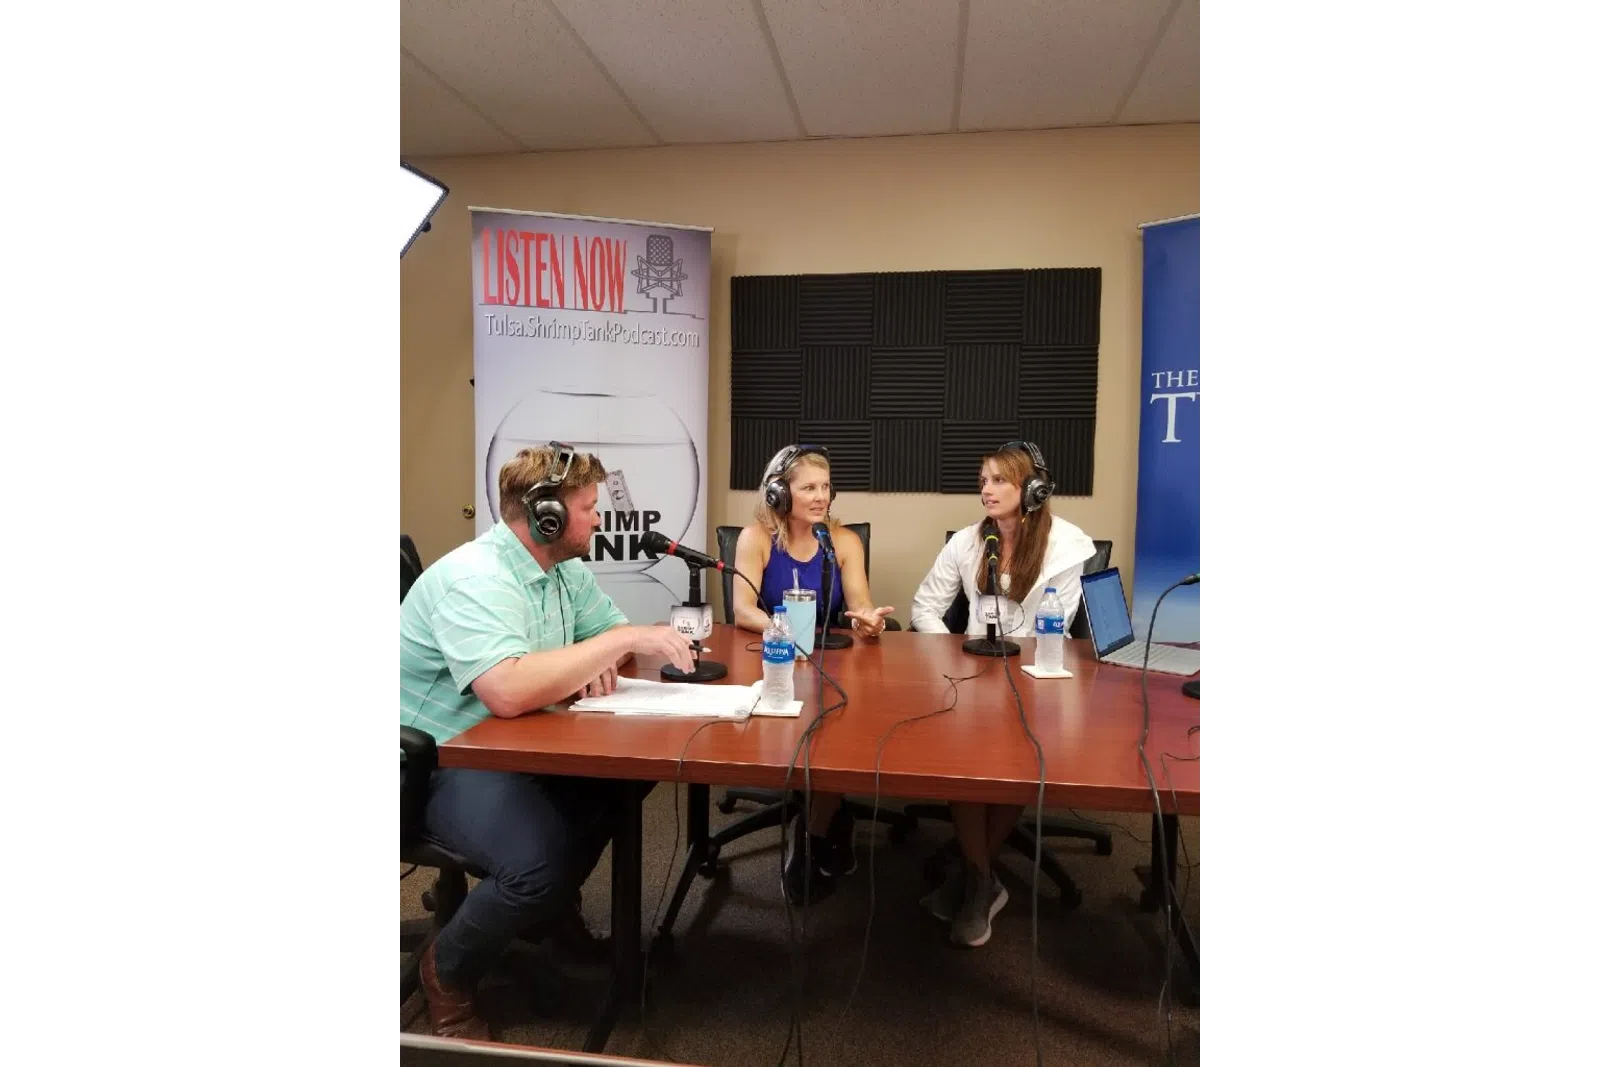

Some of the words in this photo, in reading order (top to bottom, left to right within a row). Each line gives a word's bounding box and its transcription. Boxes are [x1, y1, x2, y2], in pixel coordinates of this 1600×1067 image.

[482, 227, 565, 309] LISTEN
[573, 235, 627, 313] NOW
[485, 313, 700, 347] Tulsa.ShrimpTankPodcast.com
[1151, 370, 1199, 388] THE
[1150, 392, 1200, 443] T
[597, 510, 661, 532] IMP
[581, 534, 659, 561] NK
